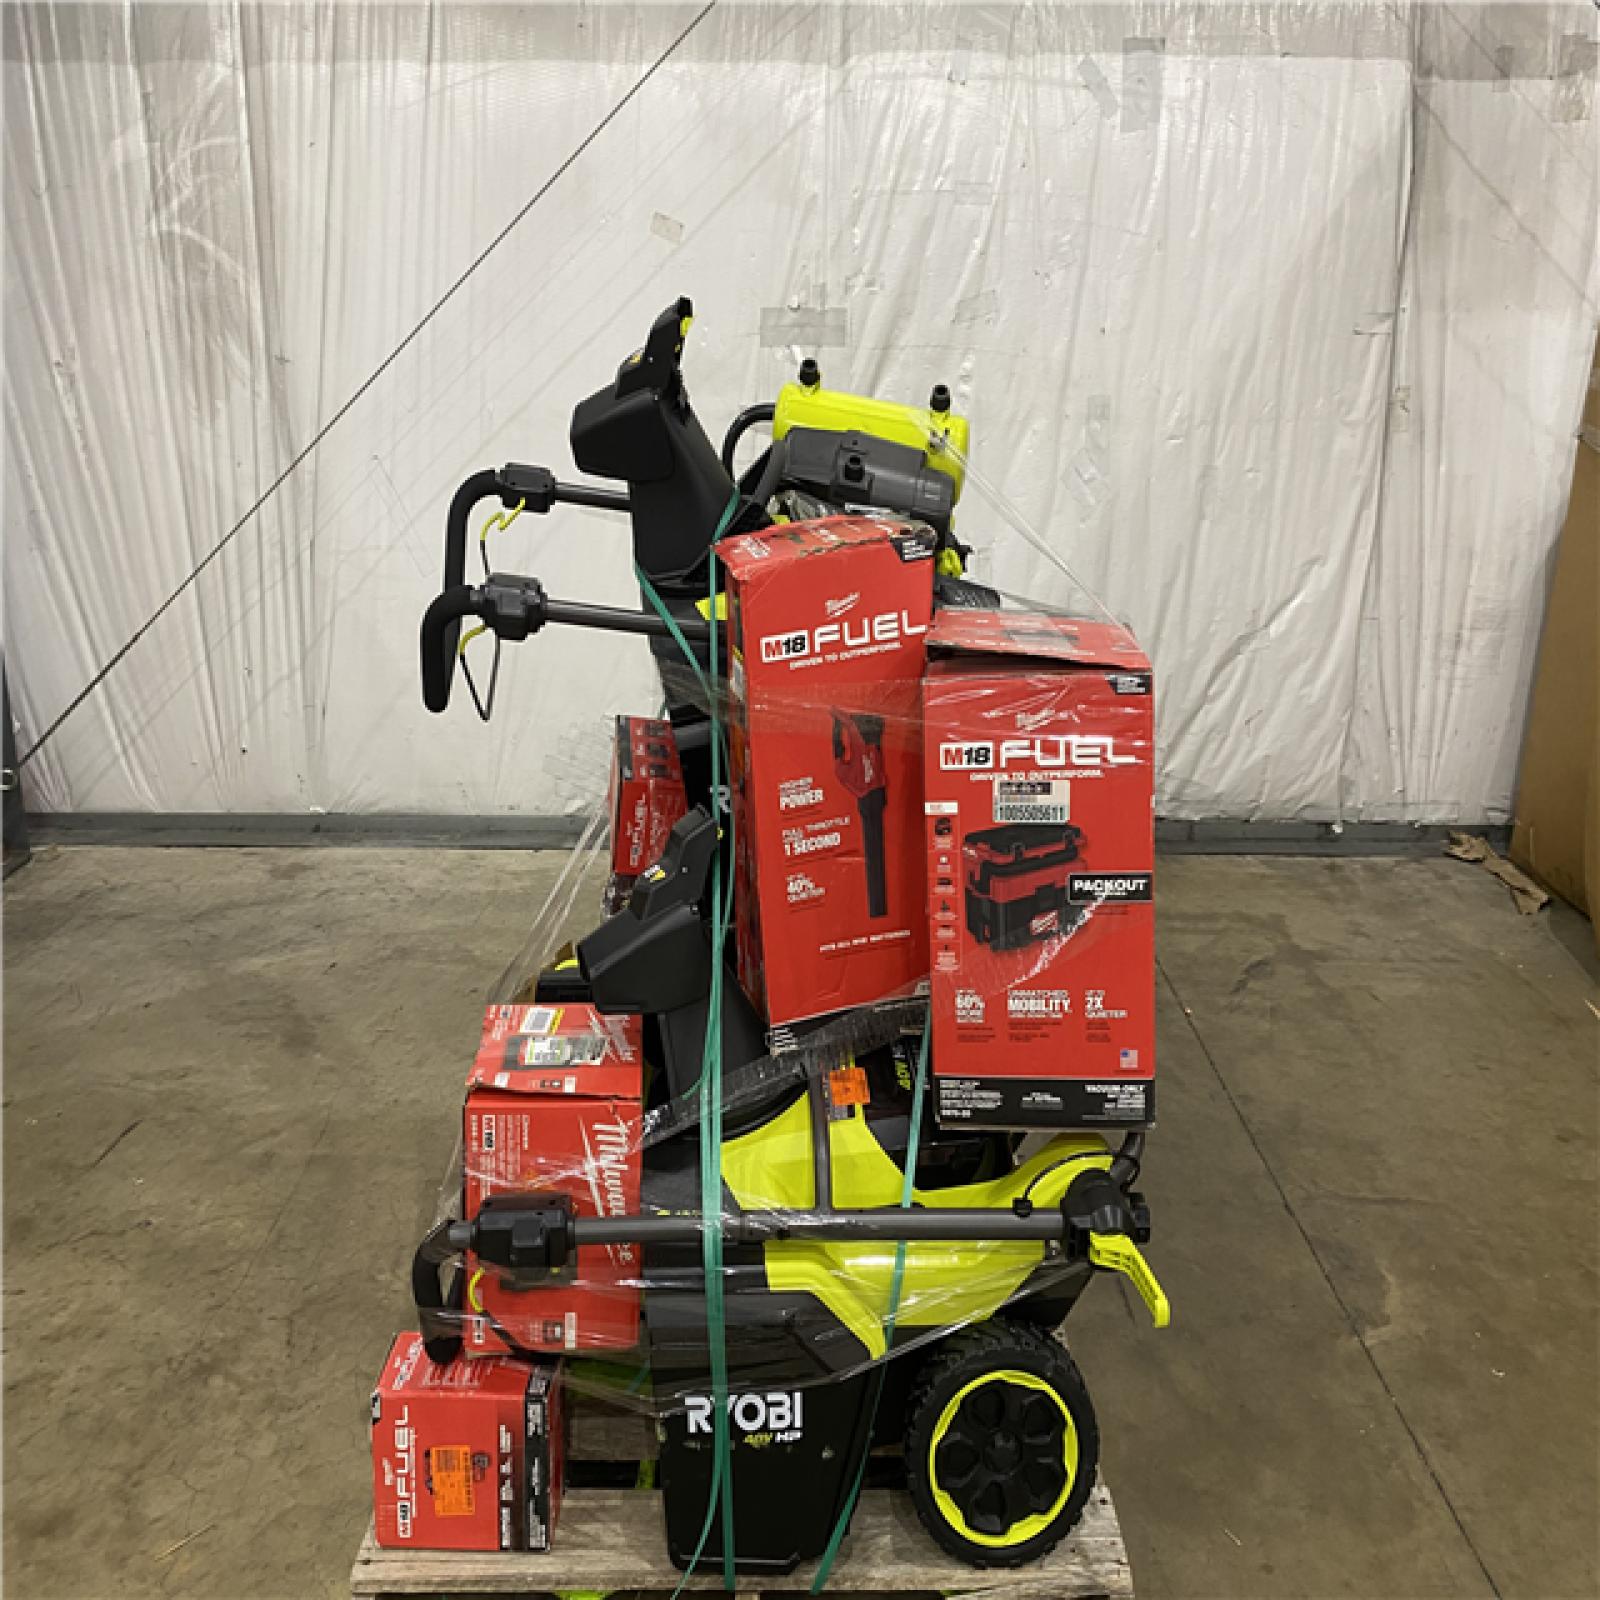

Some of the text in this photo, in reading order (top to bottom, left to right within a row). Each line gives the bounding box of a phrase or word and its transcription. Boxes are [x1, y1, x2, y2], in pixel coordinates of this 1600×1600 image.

[761, 610, 927, 662] M18 FUEL
[942, 737, 1137, 769] M18 FUEL
[779, 789, 824, 811] POWER
[795, 832, 840, 855] SECOND
[1073, 879, 1149, 892] PACKOUT
[1085, 997, 1104, 1010] 2X
[592, 1119, 635, 1263] Milwaue
[774, 1431, 803, 1443] HP
[395, 1404, 409, 1497] FUEL
